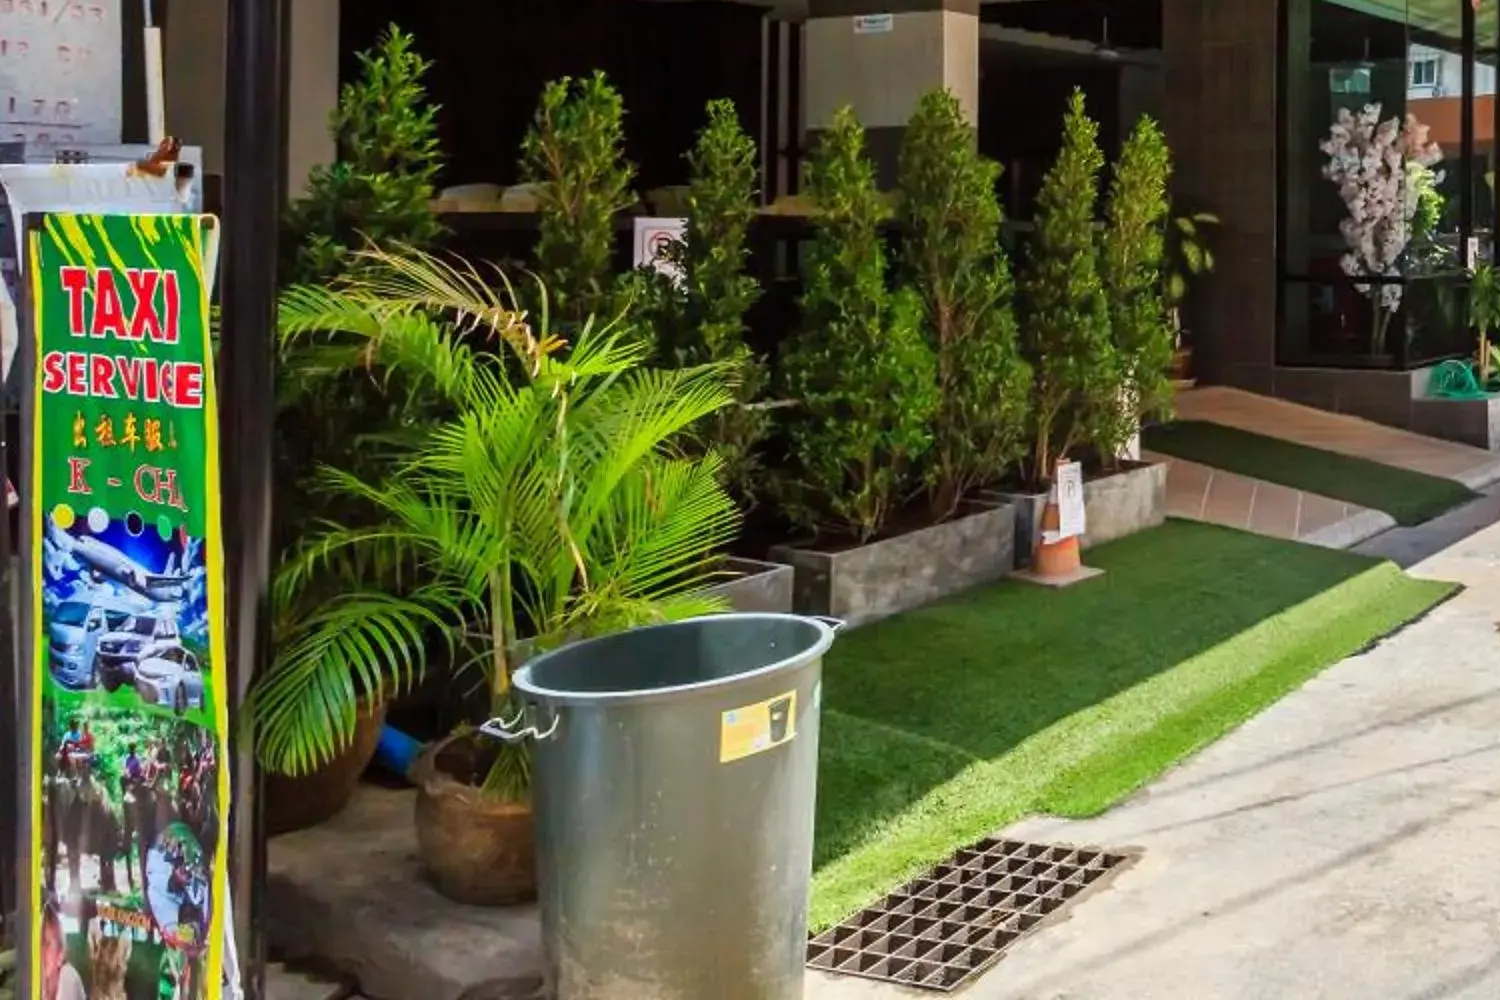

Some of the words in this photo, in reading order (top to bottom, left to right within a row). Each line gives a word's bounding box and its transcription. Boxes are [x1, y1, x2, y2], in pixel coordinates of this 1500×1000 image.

[60, 266, 181, 344] TAXI
[43, 351, 204, 408] SERVICE
[67, 456, 93, 495] K
